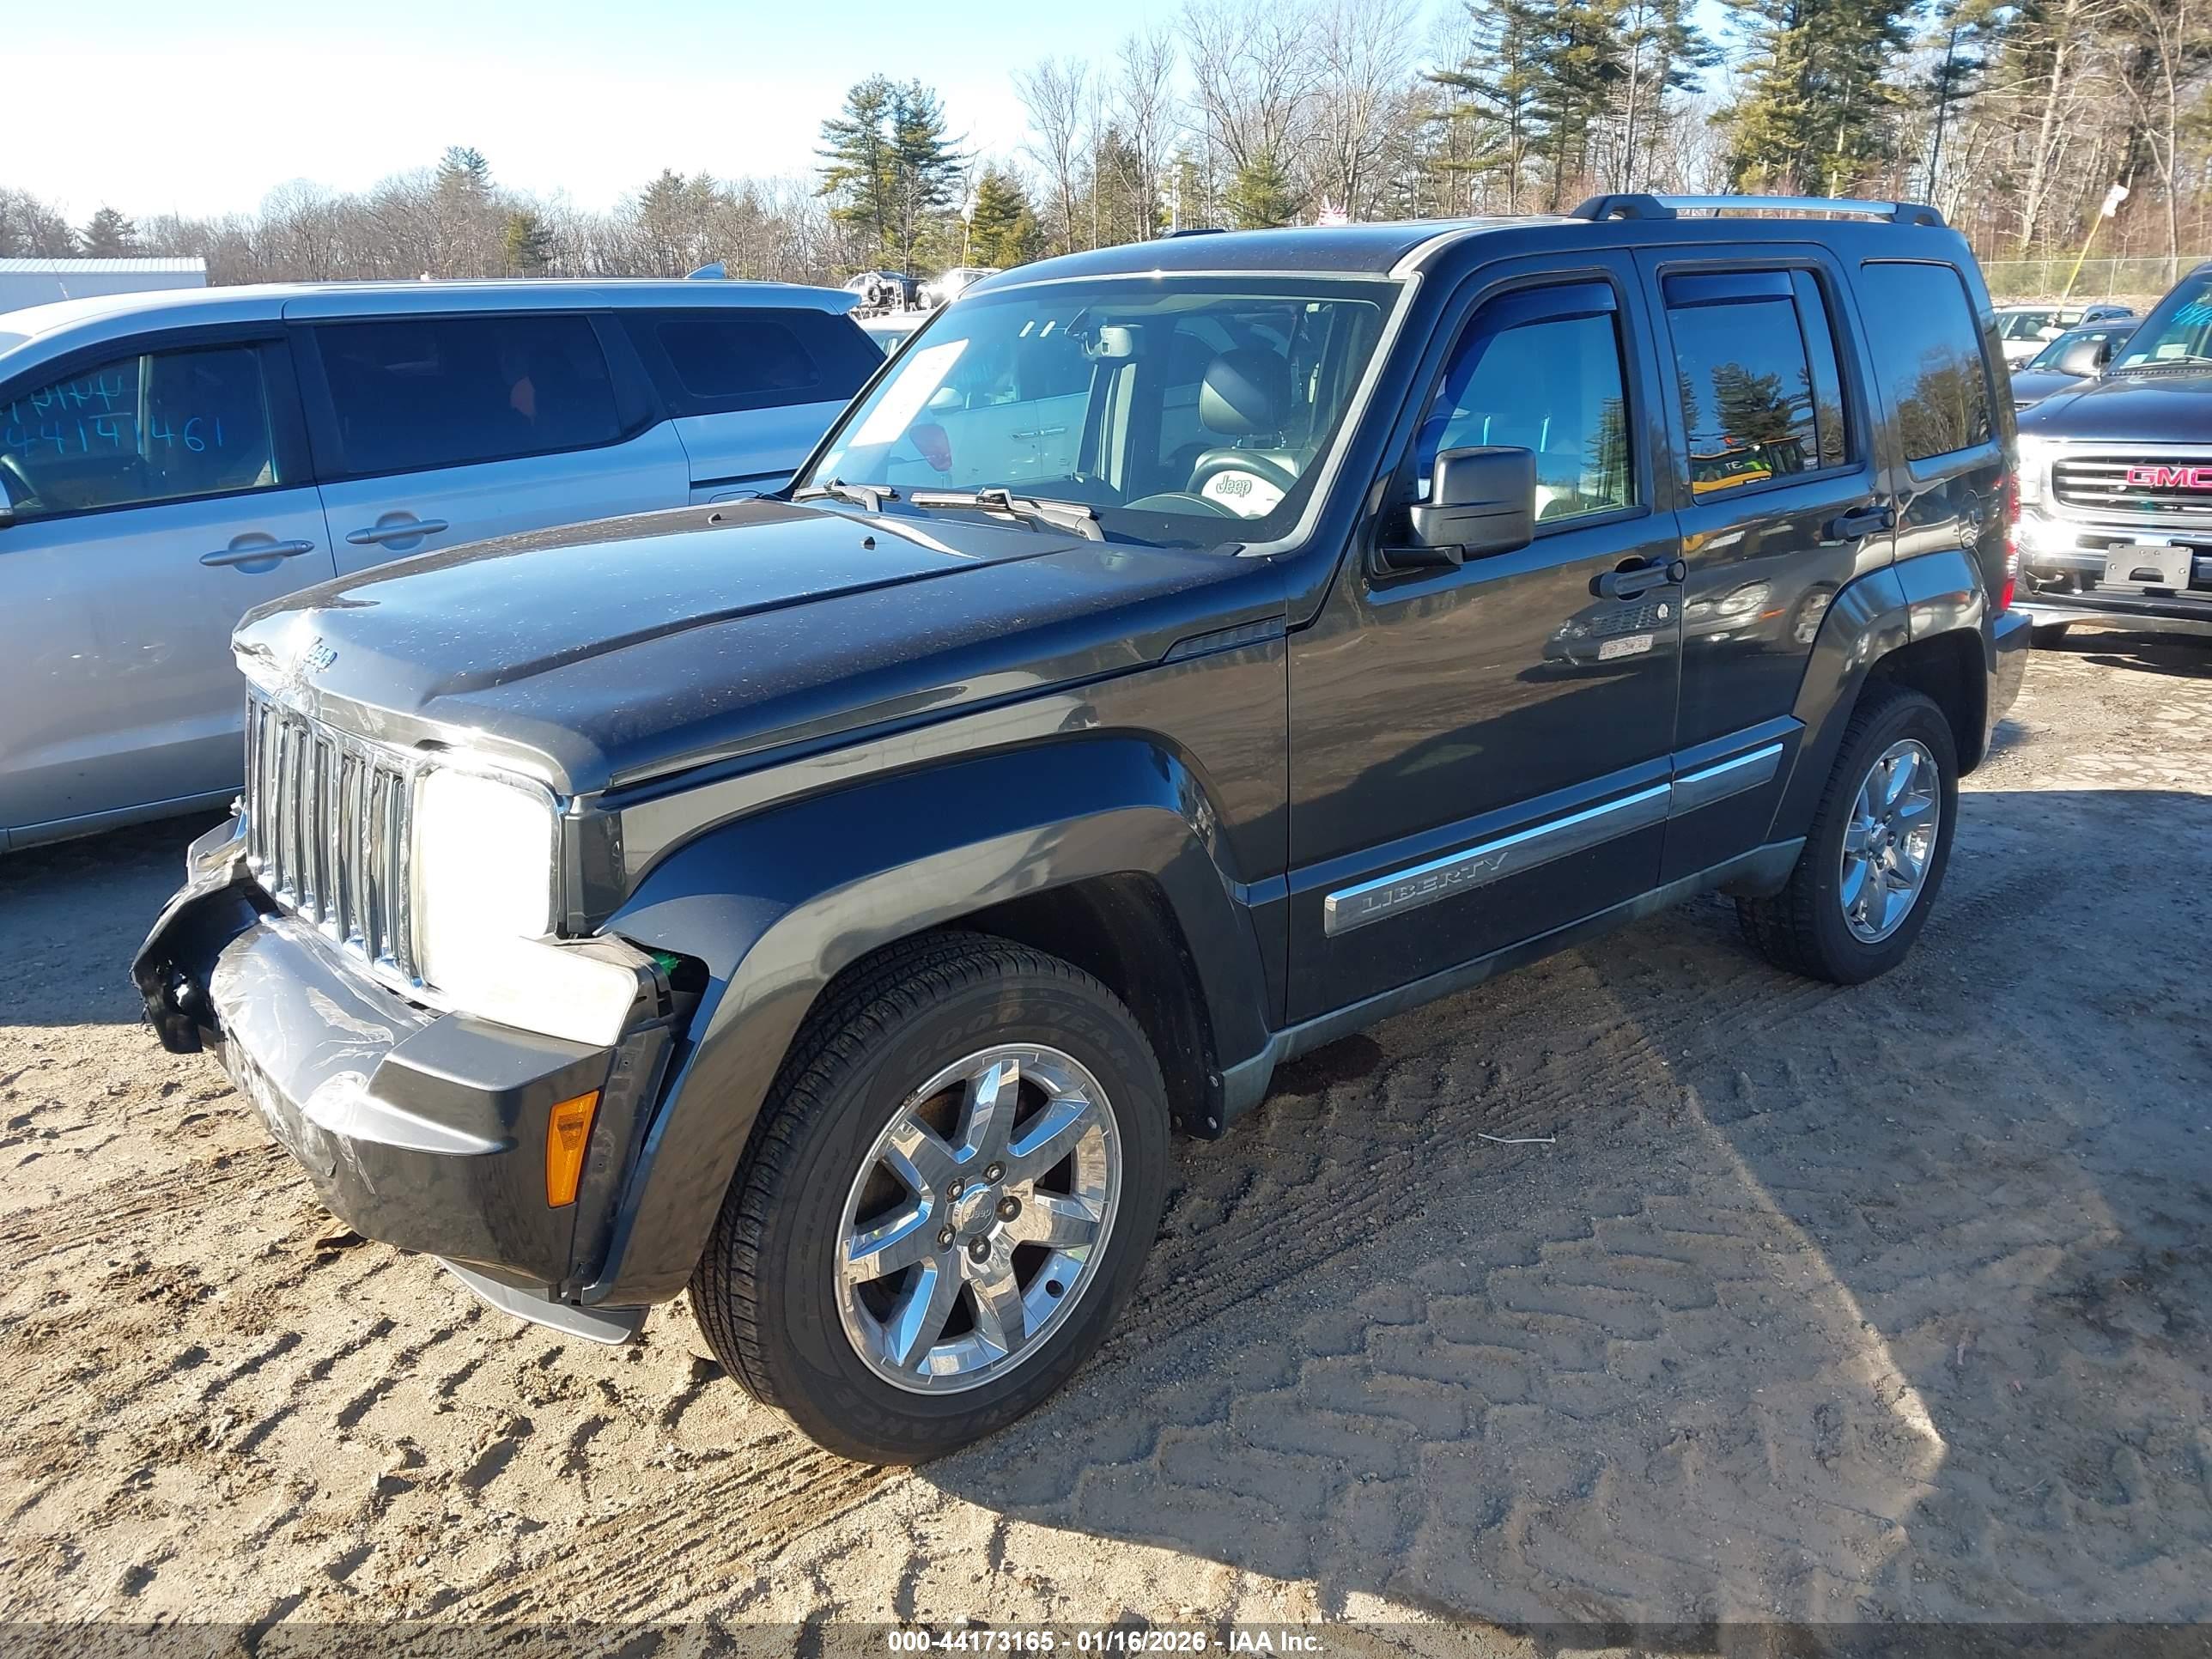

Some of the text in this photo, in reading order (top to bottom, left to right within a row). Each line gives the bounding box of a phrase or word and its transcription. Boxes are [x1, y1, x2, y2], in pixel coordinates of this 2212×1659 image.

[6, 416, 222, 457] 44141461
[1216, 475, 1252, 498] Jeep
[2126, 465, 2212, 488] GMC
[1361, 851, 1509, 914] LIBERTY
